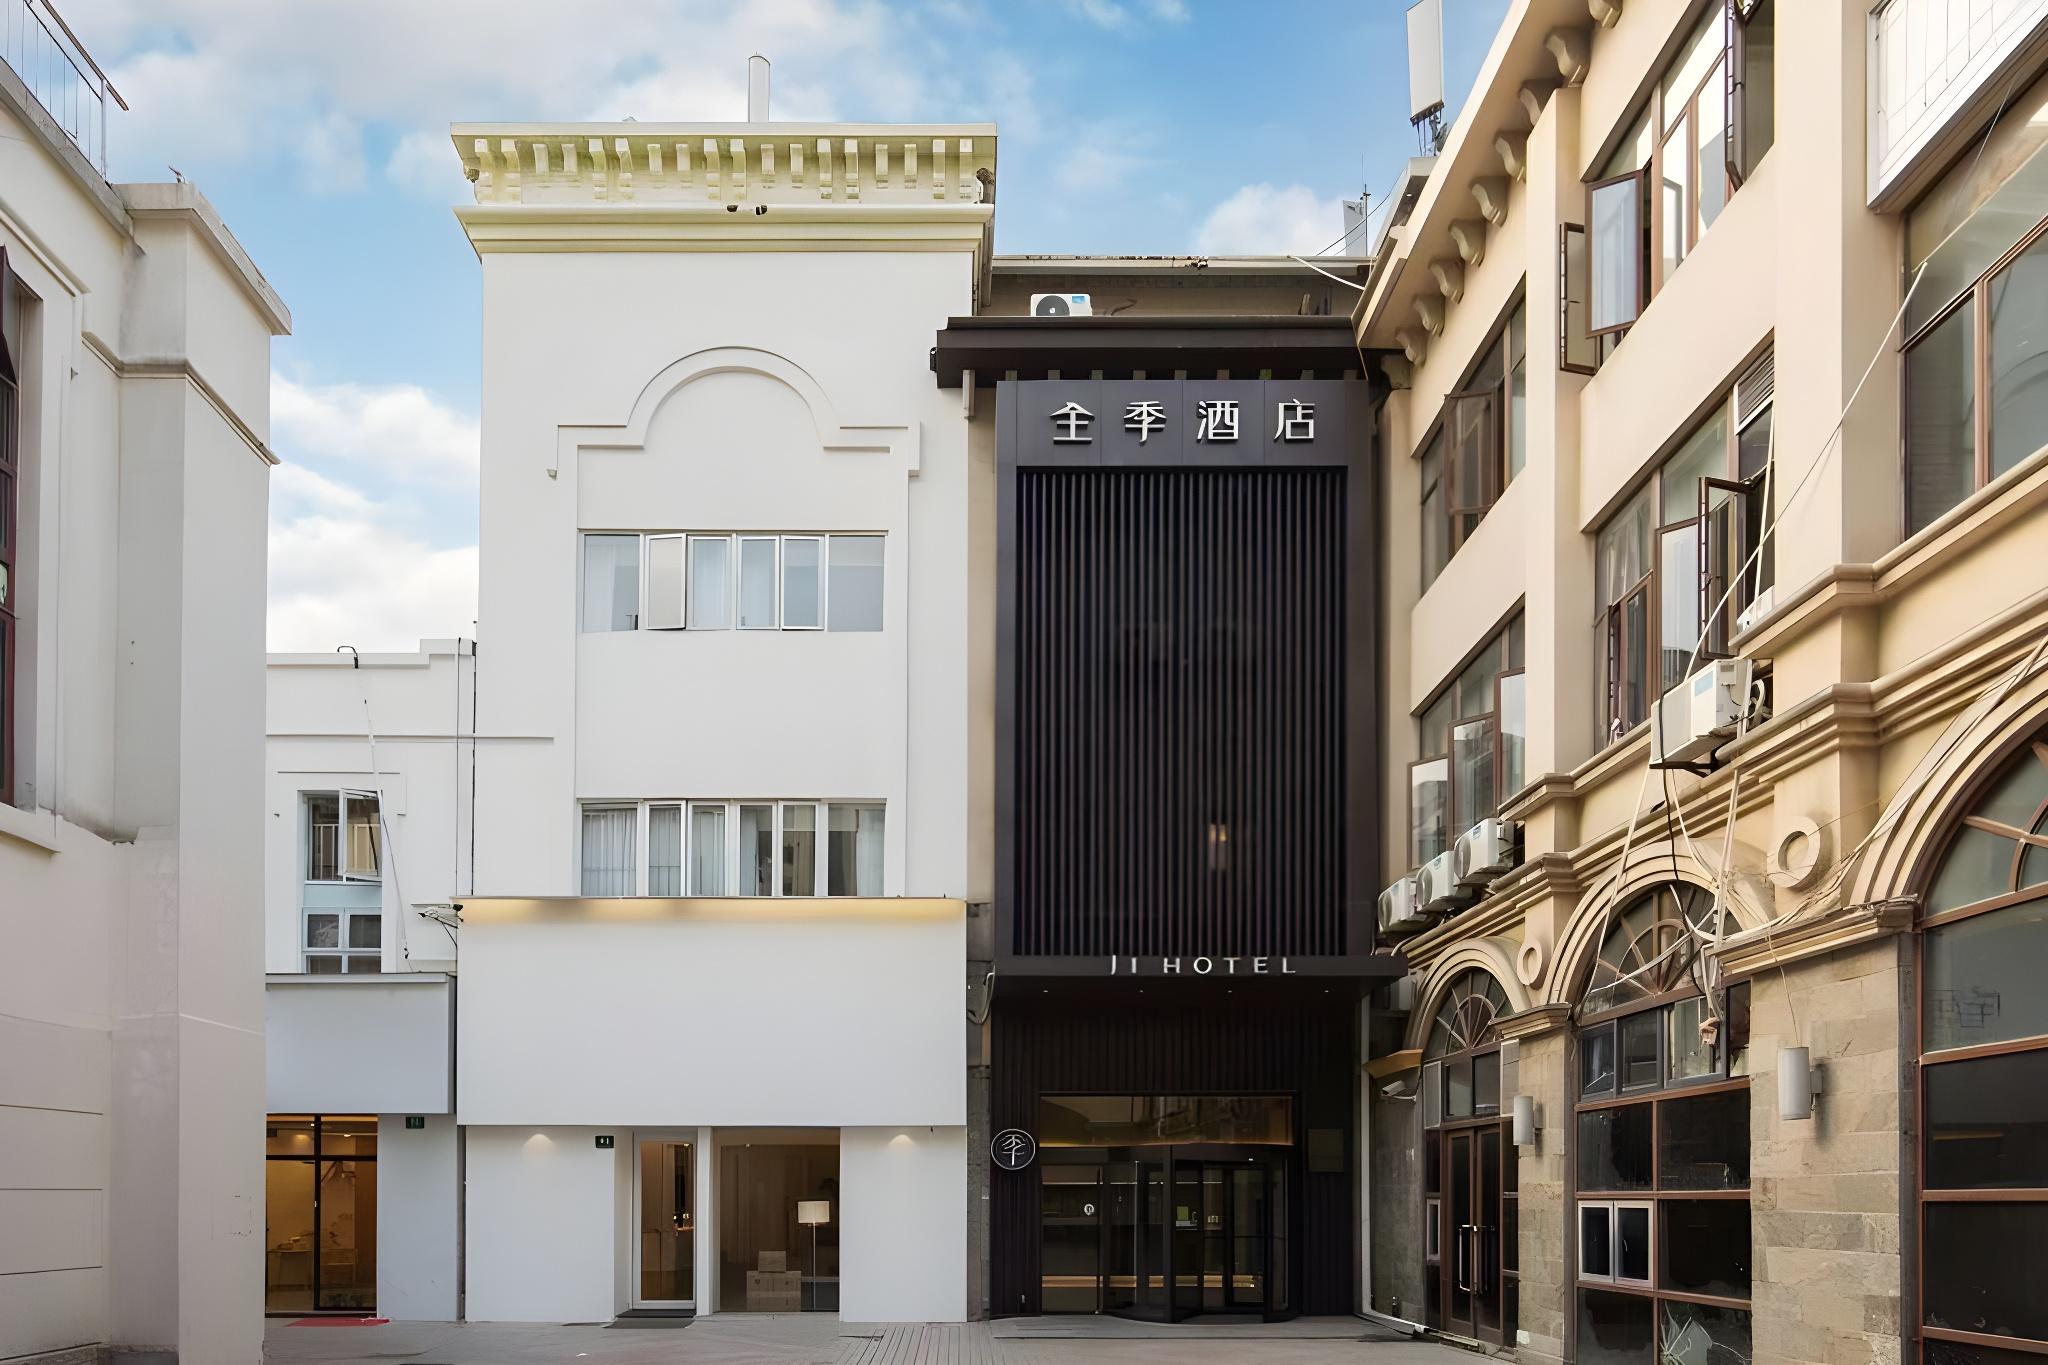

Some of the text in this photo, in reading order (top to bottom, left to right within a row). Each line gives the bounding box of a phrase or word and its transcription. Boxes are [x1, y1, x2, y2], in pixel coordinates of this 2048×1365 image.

[1049, 398, 1316, 443] 全季酒店
[1110, 954, 1297, 975] JI HOTEL
